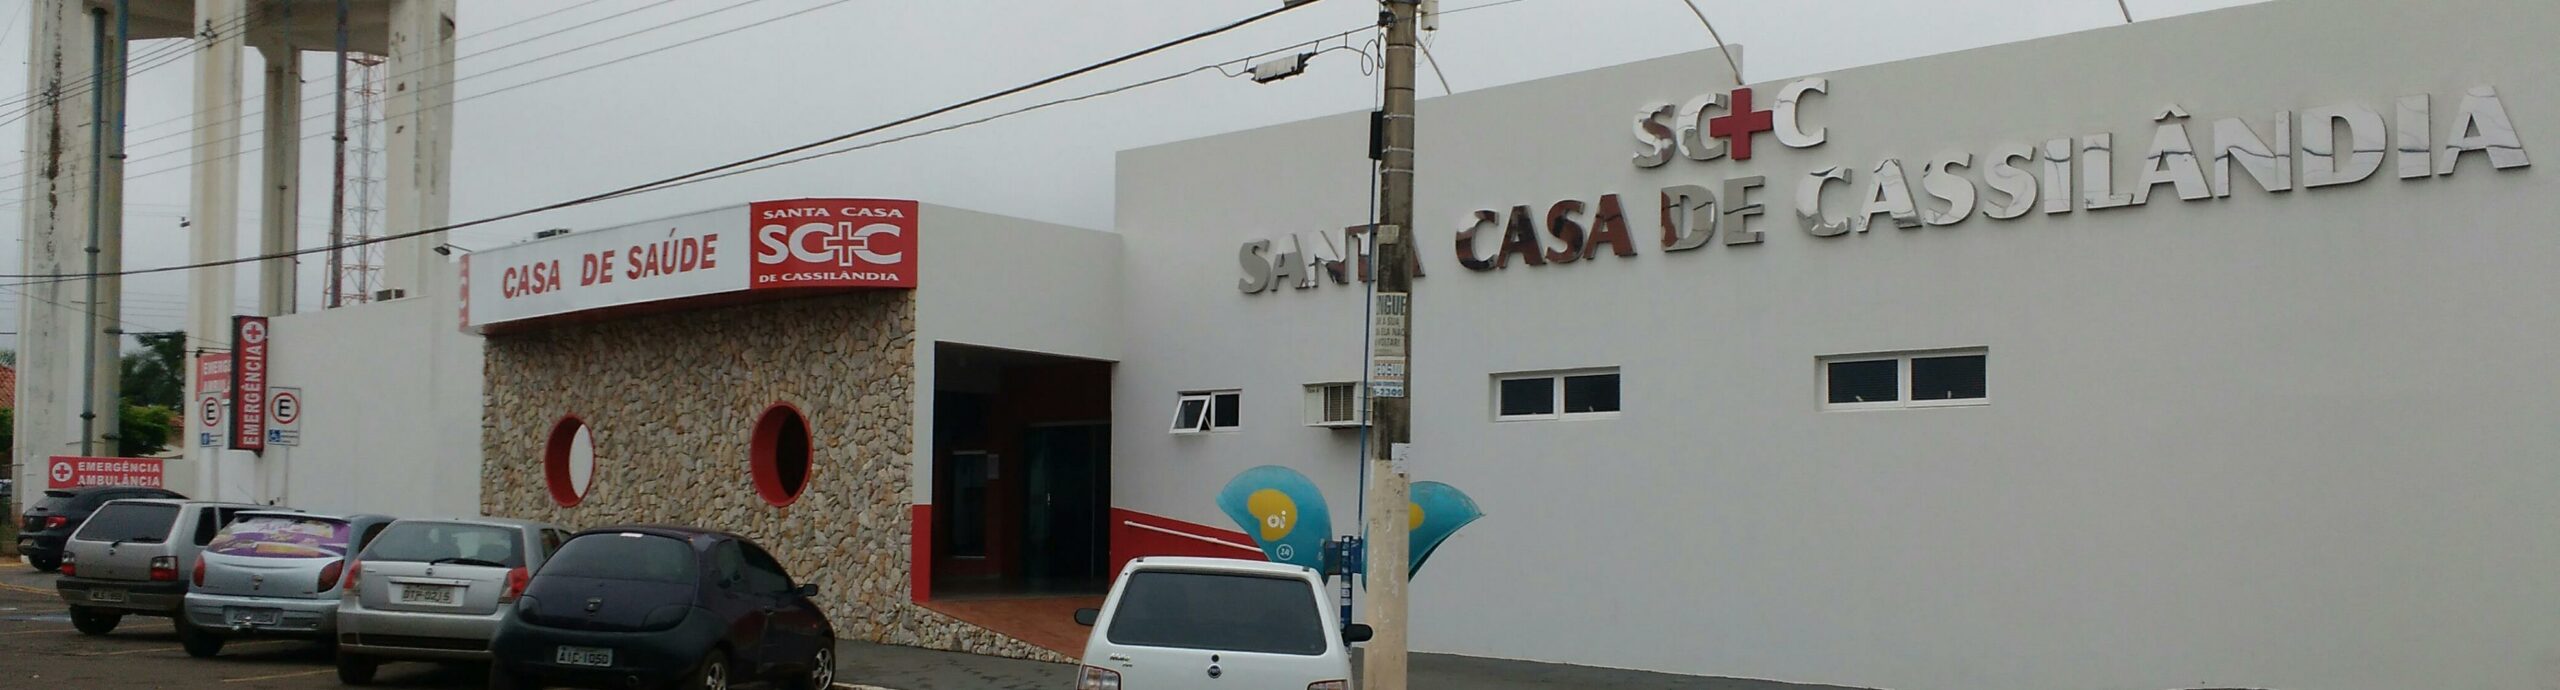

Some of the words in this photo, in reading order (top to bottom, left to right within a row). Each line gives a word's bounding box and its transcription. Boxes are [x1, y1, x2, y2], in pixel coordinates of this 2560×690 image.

[1455, 193, 1638, 272] CASA
[1660, 175, 1766, 252] DE
[1797, 85, 2532, 237] CASSILÂNDIA
[763, 207, 831, 220] SANTA
[840, 207, 905, 218] CASA
[502, 259, 561, 299] CASA
[581, 250, 615, 286] DE
[626, 227, 718, 280] SAÚDE
[759, 274, 778, 283] DE
[781, 271, 900, 281] CASSILÂNDIA
[241, 344, 263, 446] EMERGÊNCIA
[206, 403, 216, 420] E
[278, 399, 291, 417] E
[78, 461, 160, 472] EMERGÊNCIA
[77, 474, 160, 486] AMBULÂNCIA
